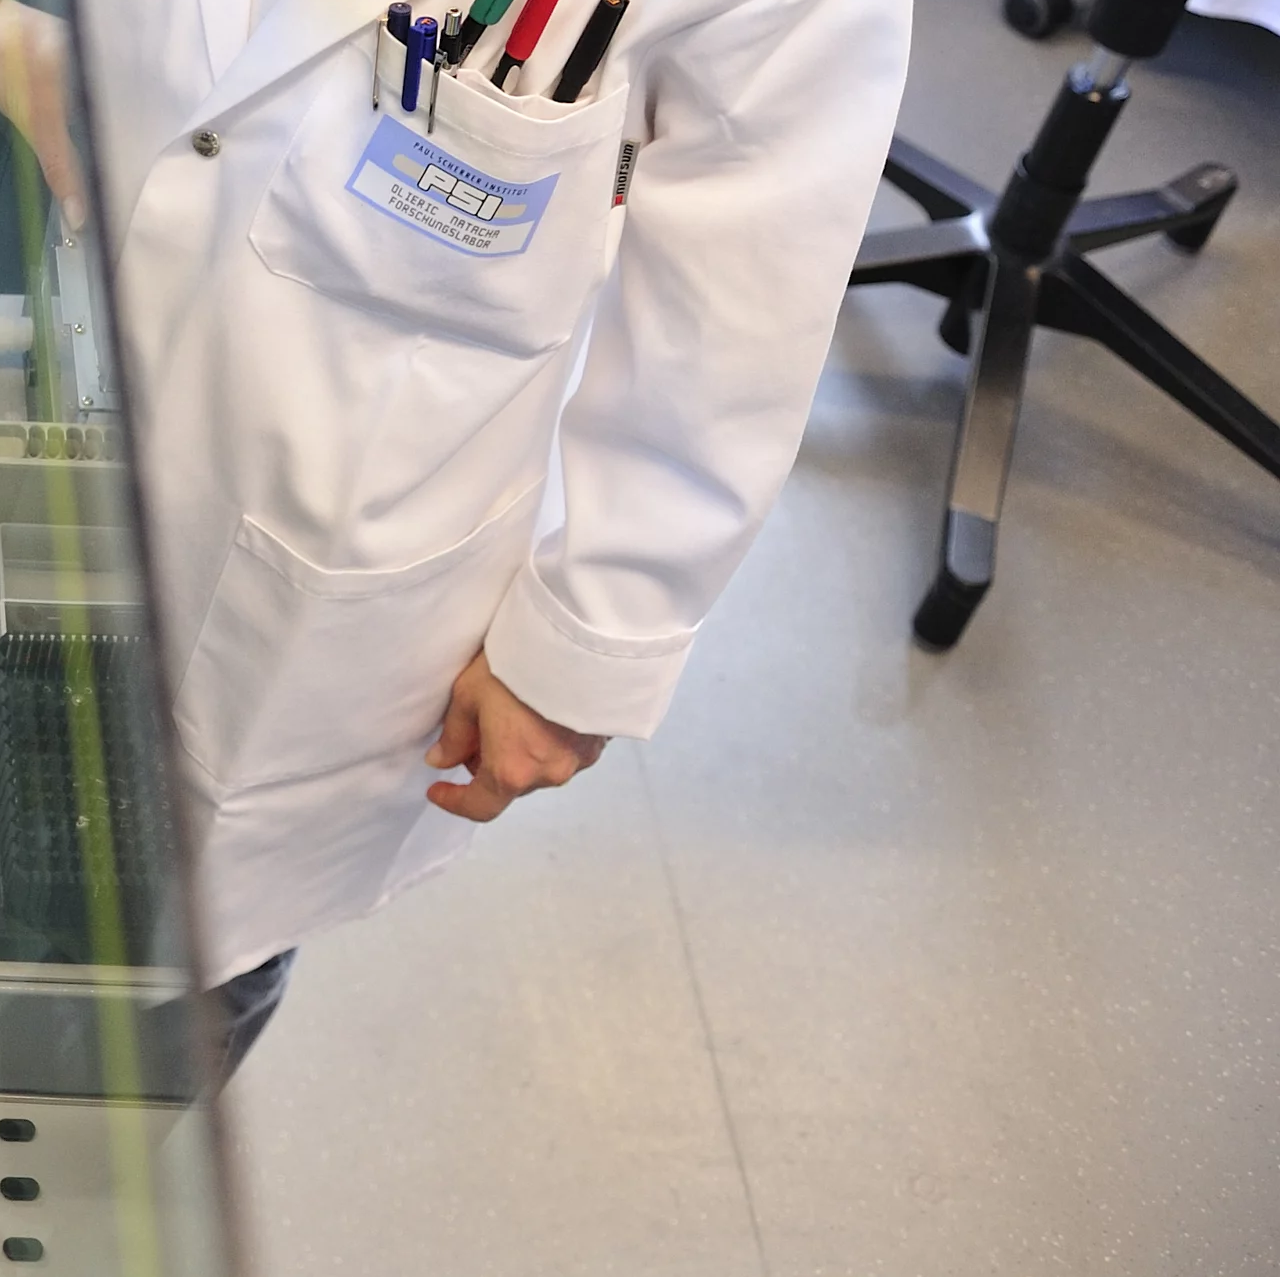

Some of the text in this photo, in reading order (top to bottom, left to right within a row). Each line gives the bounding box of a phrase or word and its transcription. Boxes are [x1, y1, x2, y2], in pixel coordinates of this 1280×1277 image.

[413, 142, 528, 196] PAUL SCHERRER INSTITUT
[417, 163, 504, 221] PSI
[616, 143, 634, 195] morsum
[388, 196, 492, 249] FORSCHUNGSLABOR
[391, 183, 500, 239] OLIERIC NATACHA
